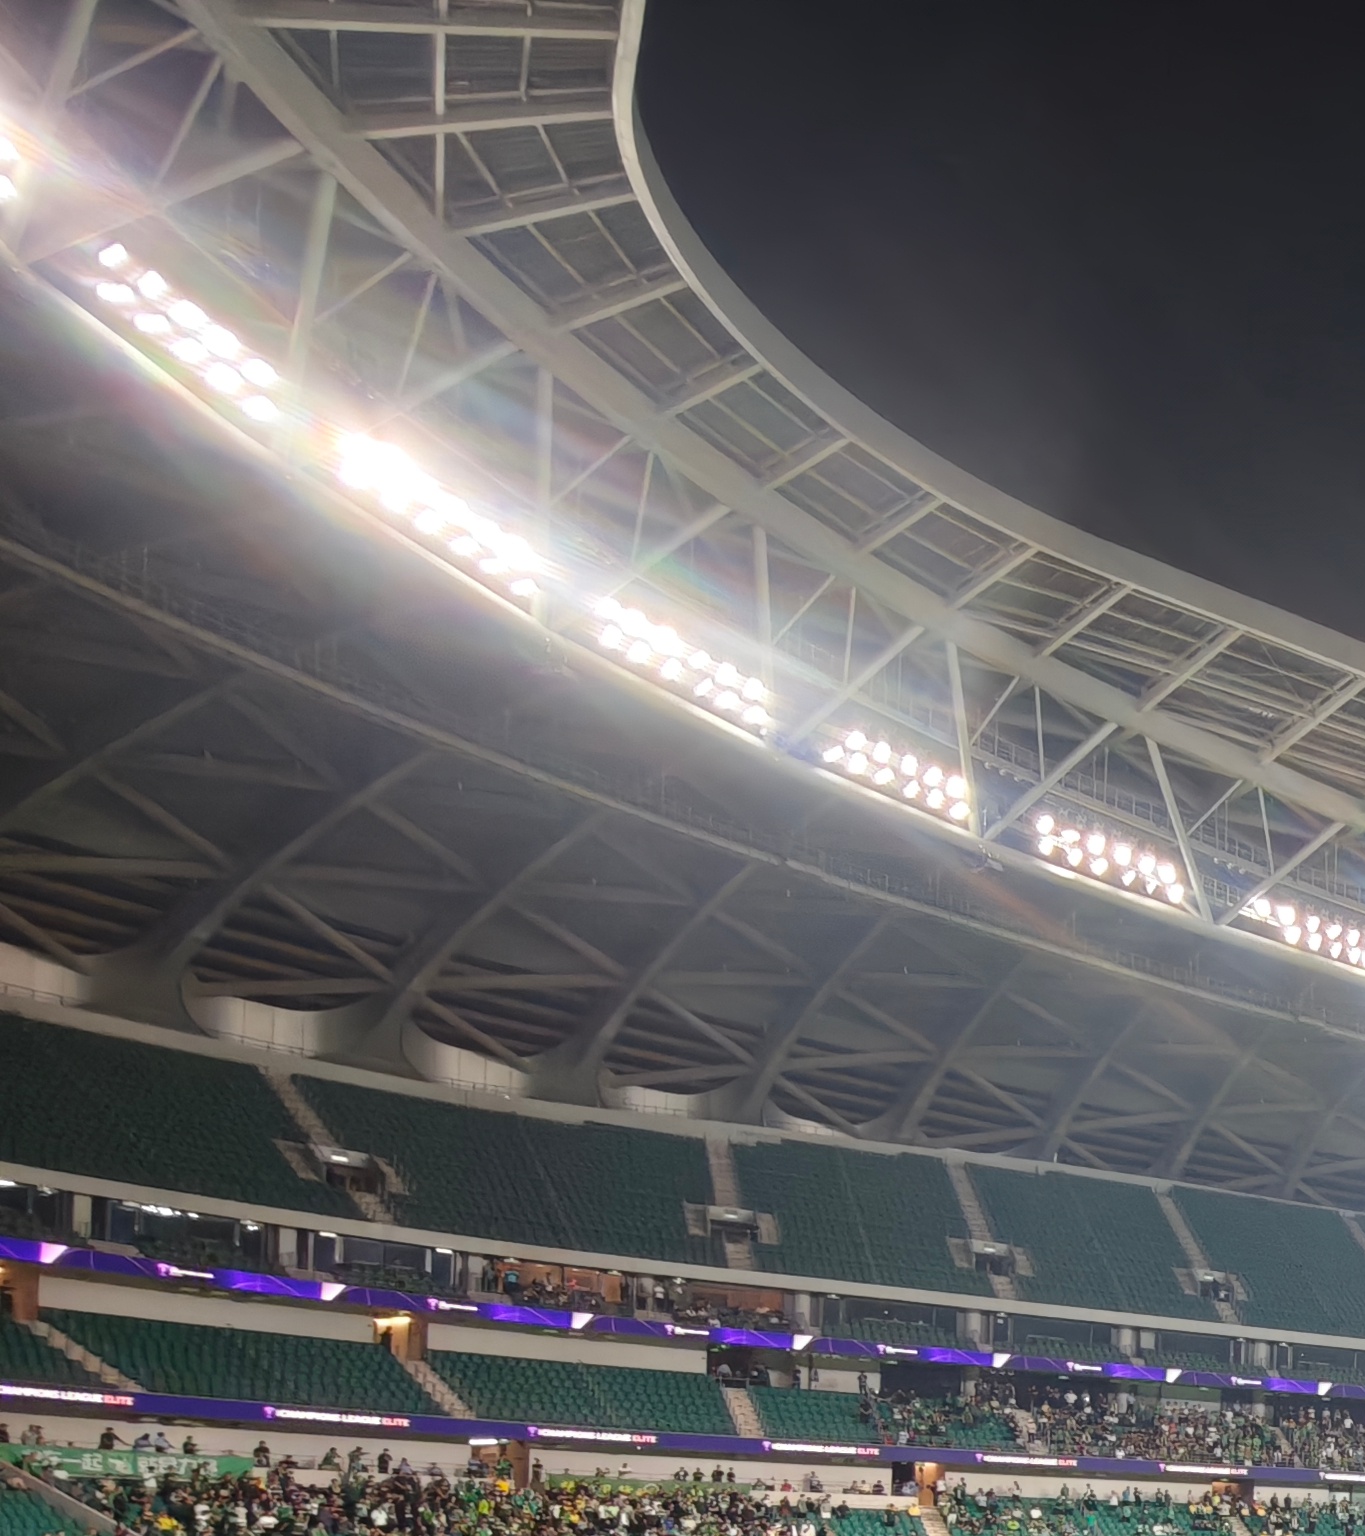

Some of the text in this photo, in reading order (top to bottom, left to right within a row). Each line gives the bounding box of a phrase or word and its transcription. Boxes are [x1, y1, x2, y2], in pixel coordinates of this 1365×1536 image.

[104, 1395, 134, 1407] ELITE
[382, 1417, 411, 1428] ELITE
[632, 1434, 657, 1445] ELITE
[858, 1447, 880, 1456] ELITE
